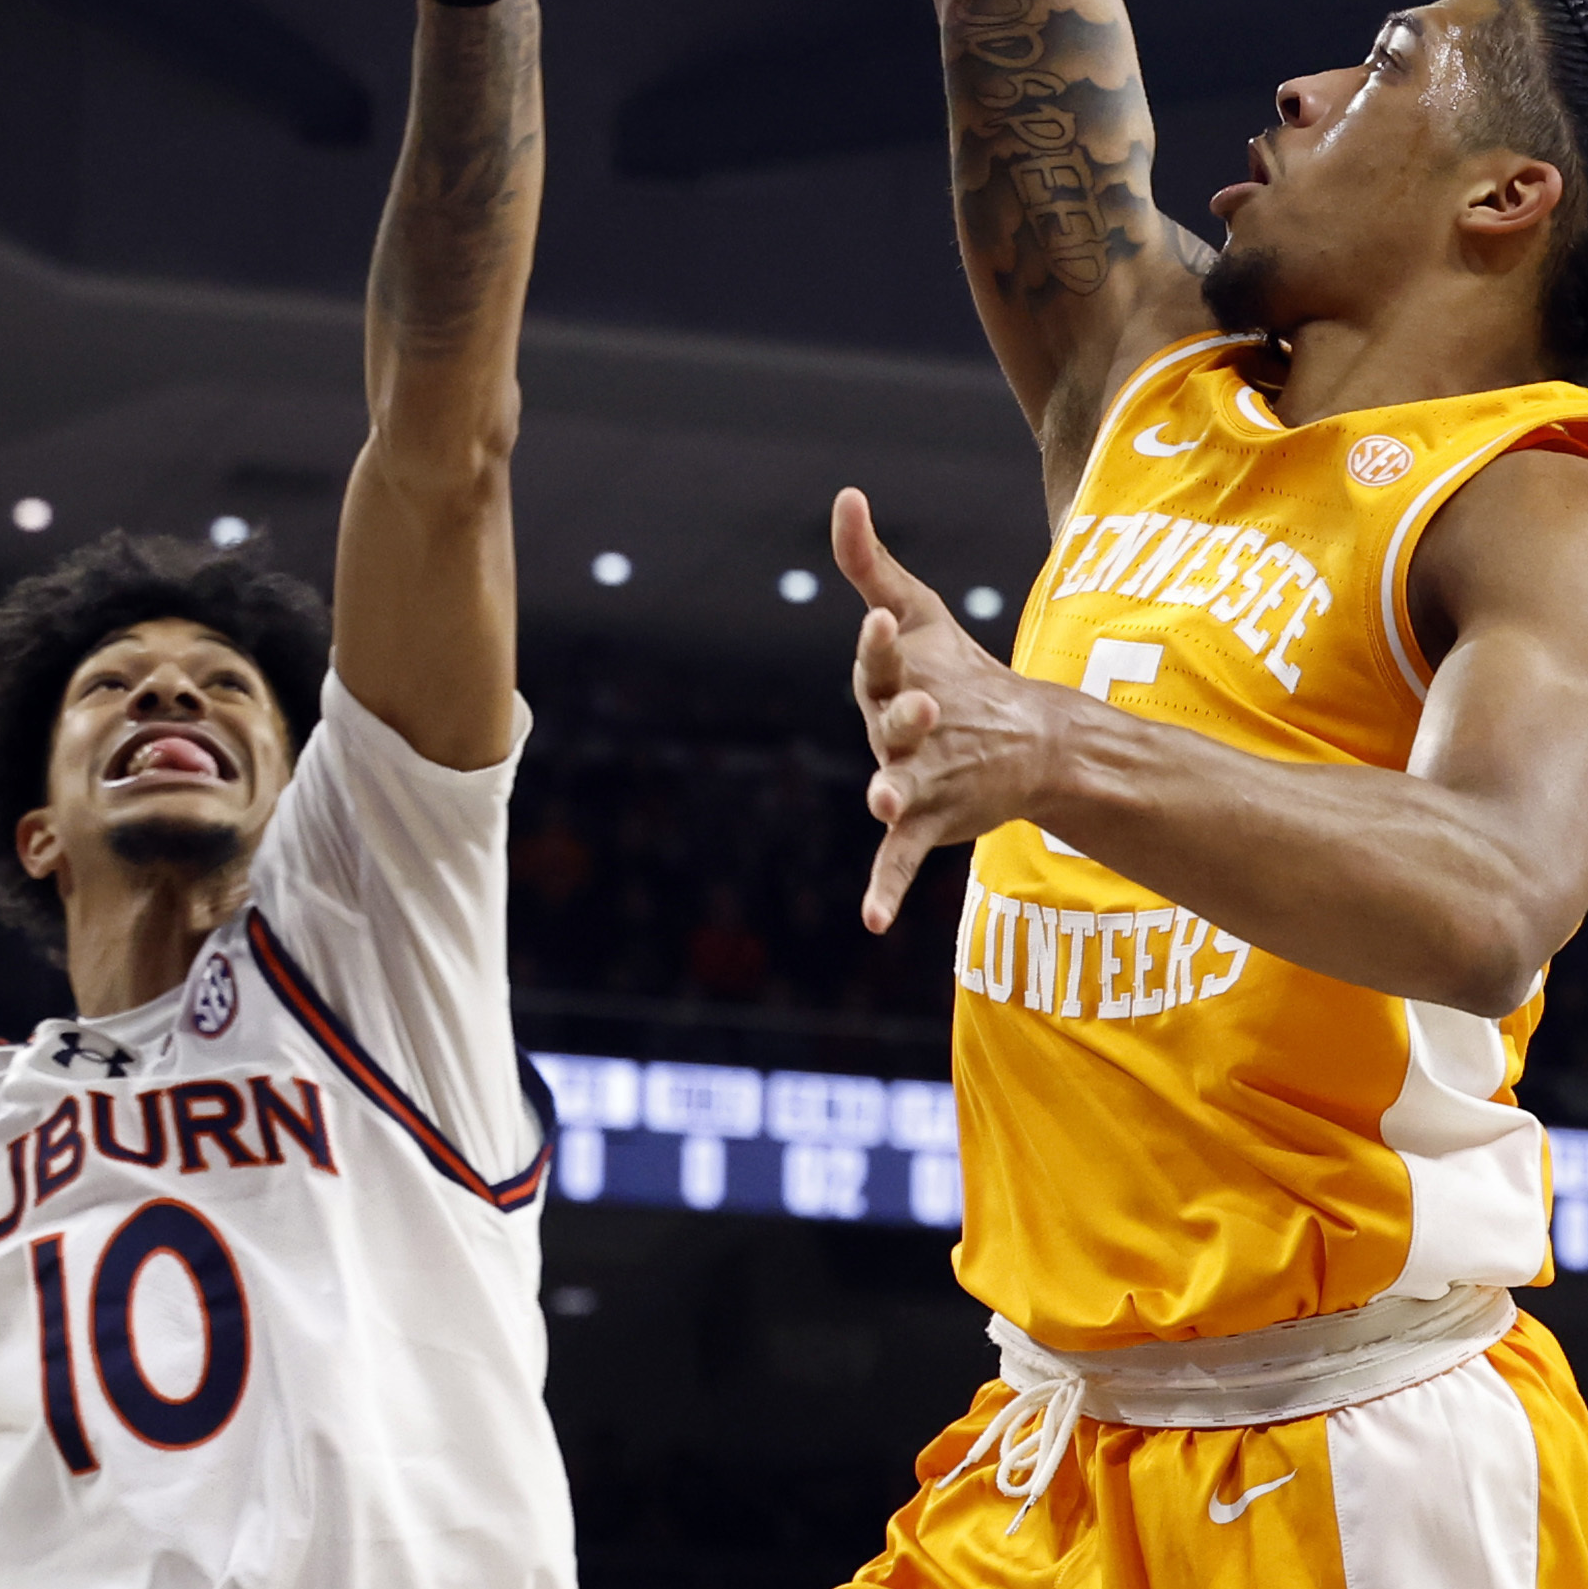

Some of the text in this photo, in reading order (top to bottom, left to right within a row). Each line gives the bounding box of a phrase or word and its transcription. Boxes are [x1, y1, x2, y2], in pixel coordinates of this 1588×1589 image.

[1353, 440, 1408, 482] SEC
[954, 867, 1251, 1019] LUNTEERS
[29, 1196, 252, 1475] 10
